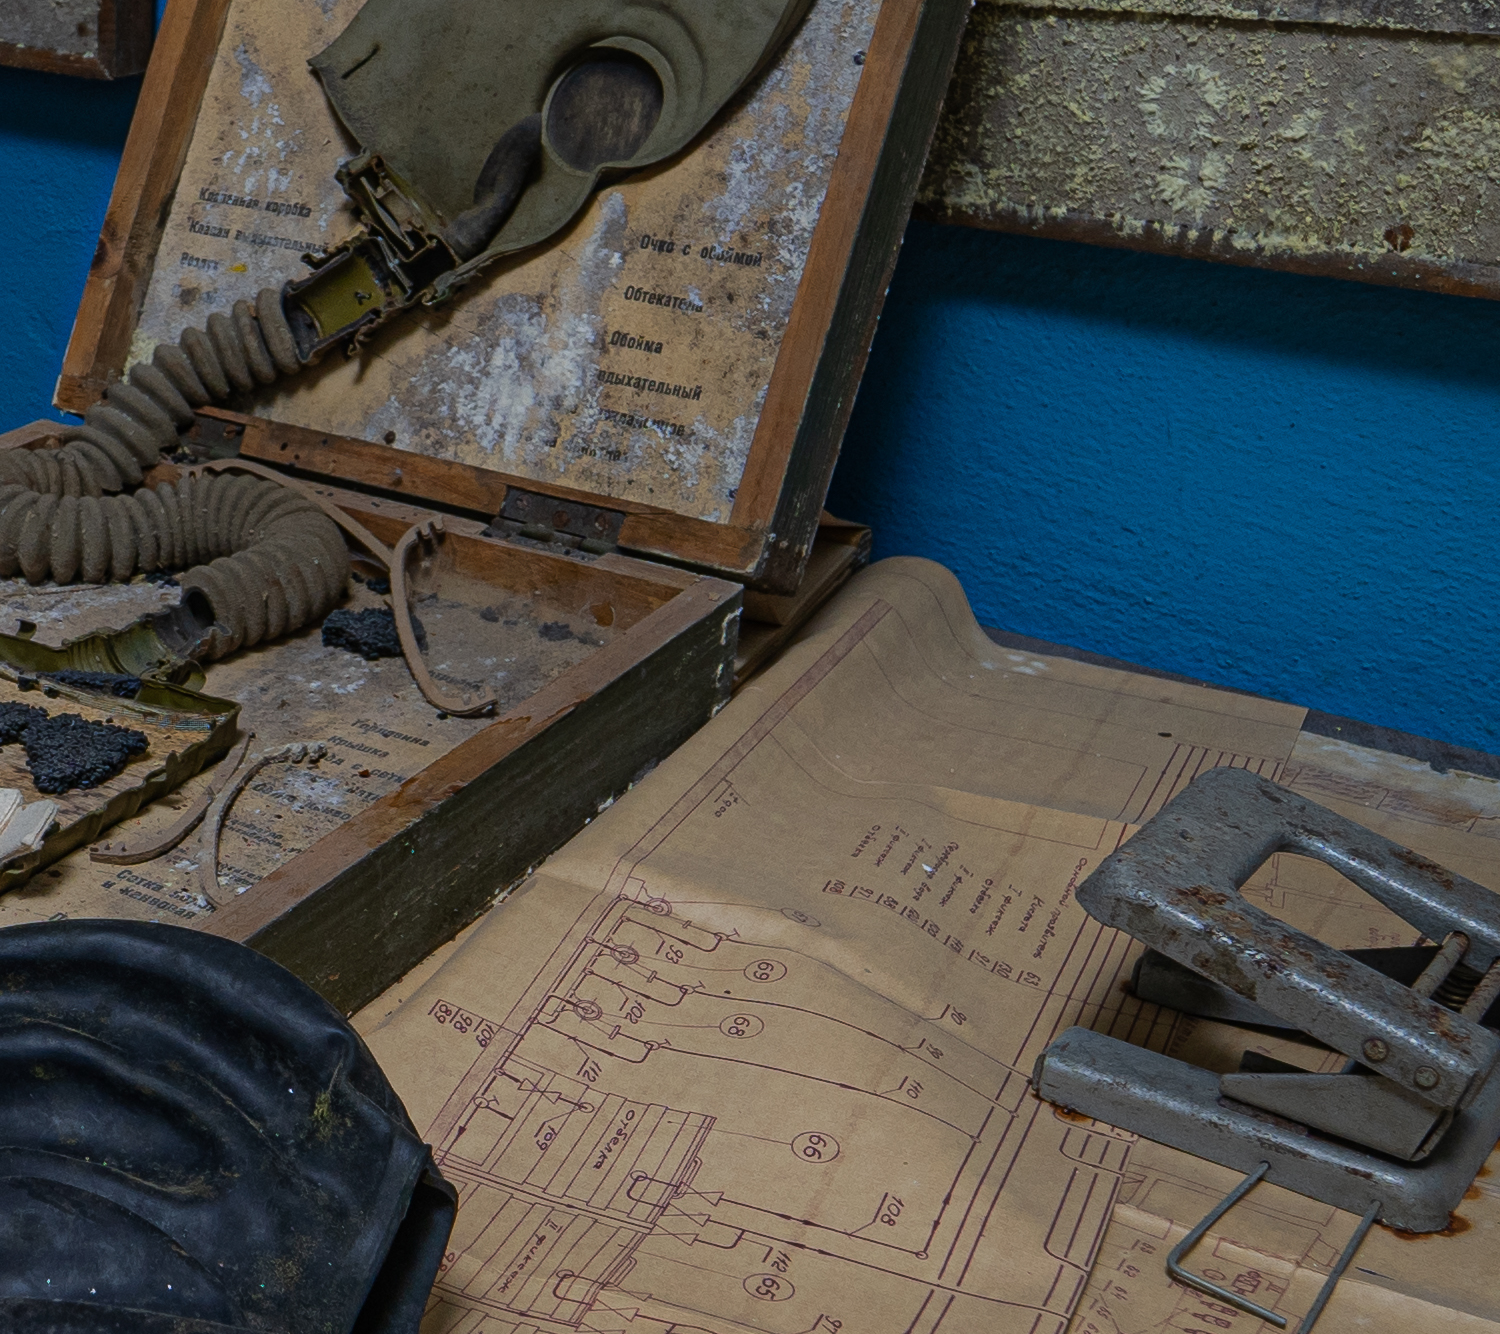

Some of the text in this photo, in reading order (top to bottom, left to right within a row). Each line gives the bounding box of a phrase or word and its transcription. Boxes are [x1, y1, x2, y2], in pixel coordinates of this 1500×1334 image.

[640, 234, 675, 254] Очко
[609, 330, 664, 355] Обойма
[597, 369, 703, 401] вдыхательный
[327, 734, 390, 759] Крышка
[664, 943, 684, 965] 93
[753, 960, 774, 981] 69
[624, 1003, 648, 1026] 102
[728, 1015, 751, 1037] 68
[582, 1059, 603, 1083] 112
[535, 1124, 558, 1152] 109
[592, 1108, 637, 1170] отбелка
[803, 1133, 829, 1161] 66
[880, 1196, 906, 1228] 108
[498, 1233, 545, 1295] фиксаж
[771, 1250, 794, 1275] 112
[755, 1277, 782, 1299] 65
